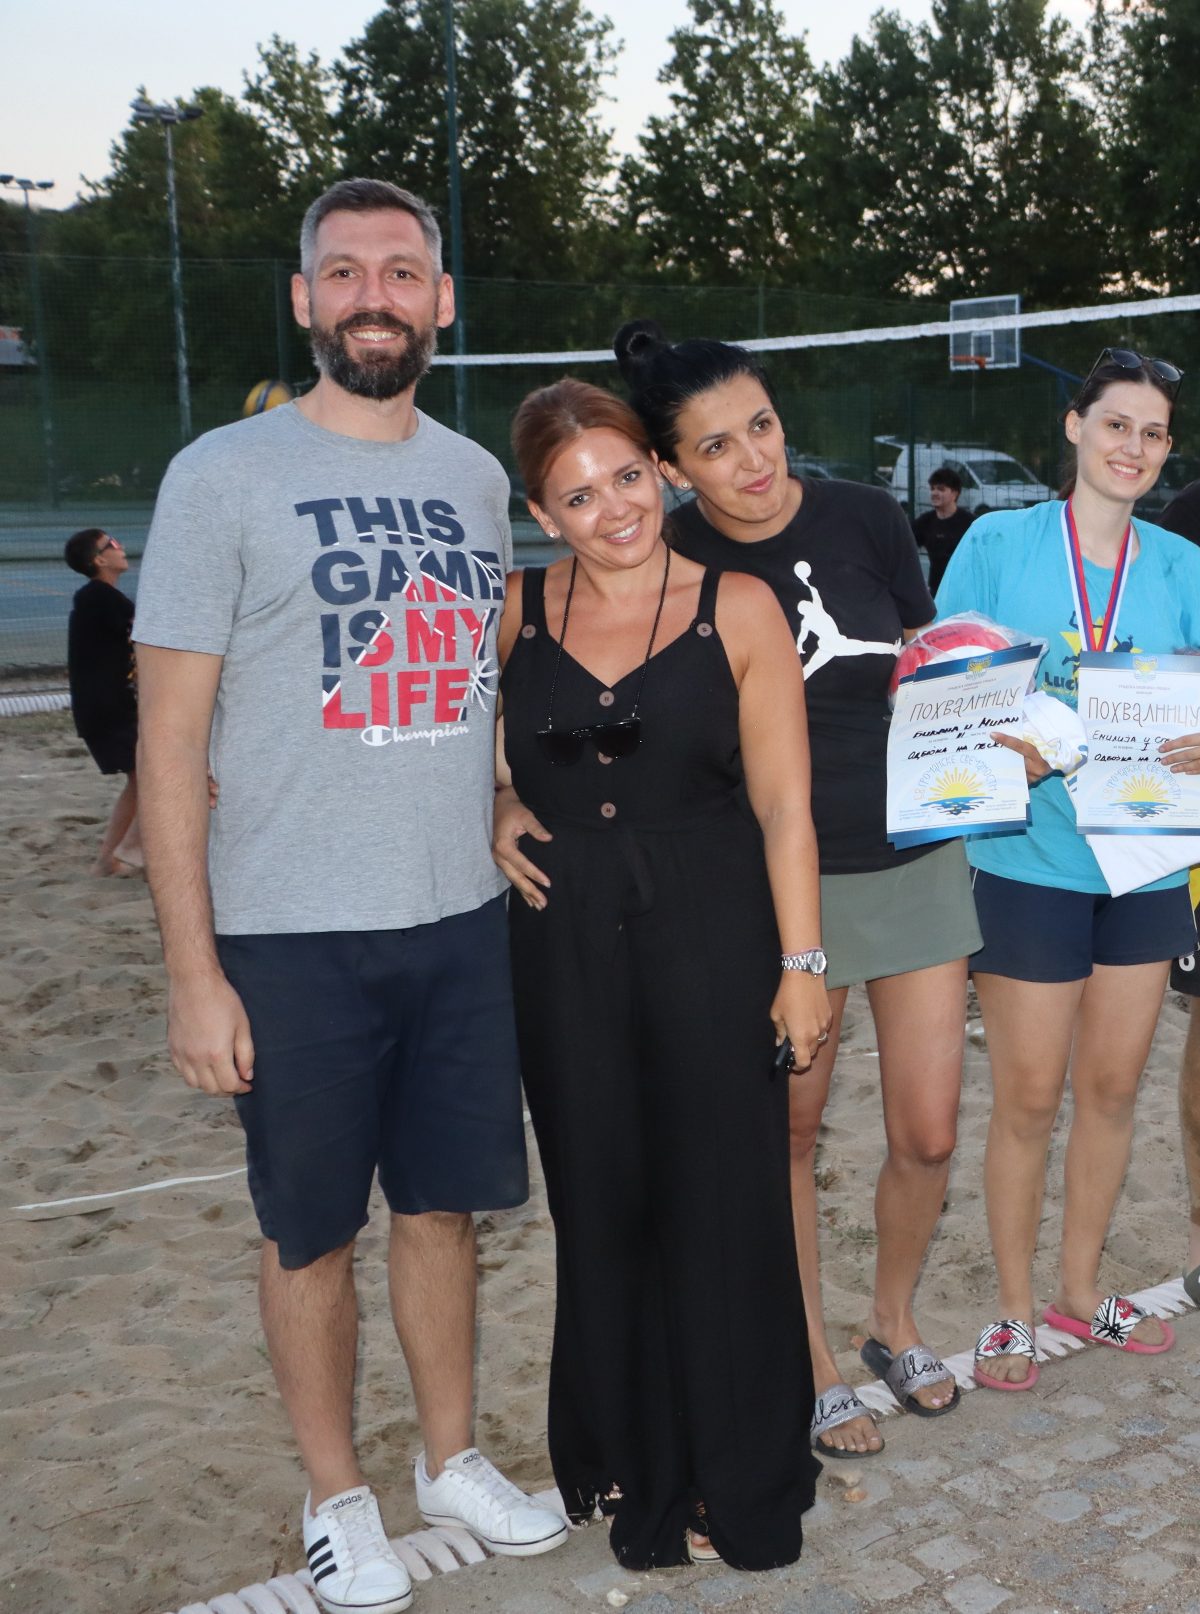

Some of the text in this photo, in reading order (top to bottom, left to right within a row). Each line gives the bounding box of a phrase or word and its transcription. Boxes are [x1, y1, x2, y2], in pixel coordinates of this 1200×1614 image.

[294, 497, 465, 546] THIS
[312, 549, 504, 605] GAME
[321, 608, 498, 668] IS MY
[322, 668, 470, 729] LIFE
[360, 723, 470, 746] Champion
[331, 1493, 363, 1510] adidas
